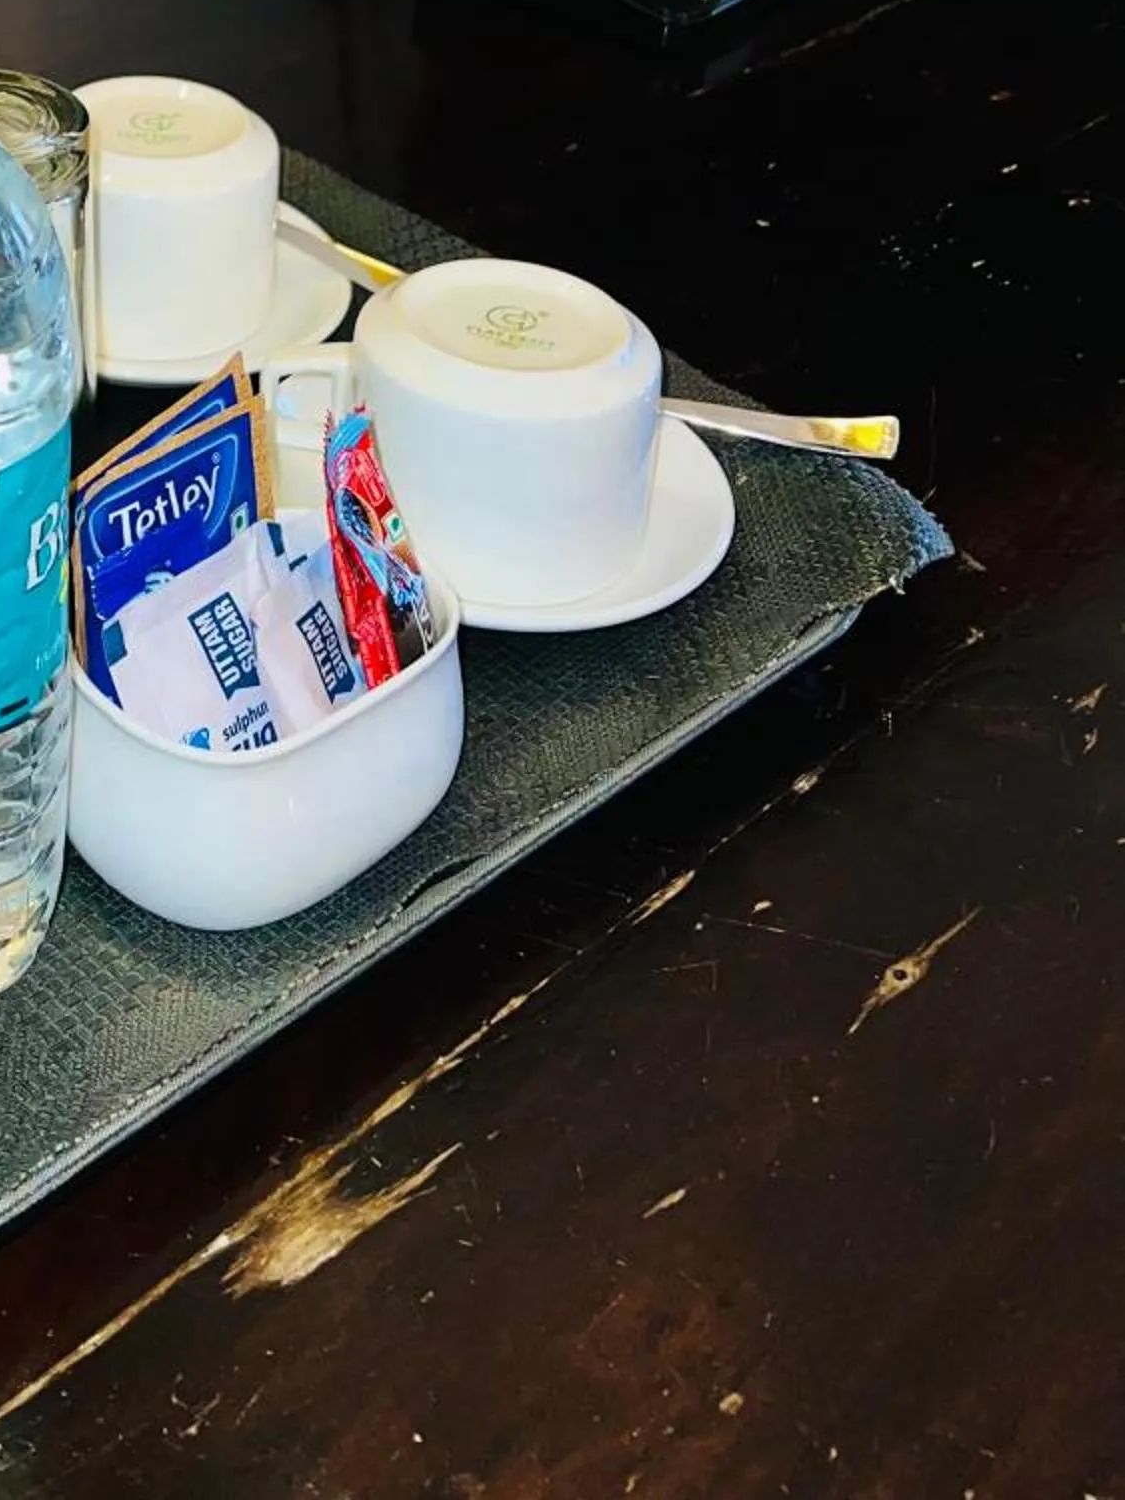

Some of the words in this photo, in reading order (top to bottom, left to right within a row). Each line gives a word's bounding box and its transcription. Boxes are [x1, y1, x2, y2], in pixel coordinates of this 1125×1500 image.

[107, 464, 221, 550] Tetley
[193, 604, 241, 690] UTTAM
[213, 596, 258, 674] SUGAR
[300, 612, 337, 692] UTTAM
[316, 600, 350, 679] SUGAR
